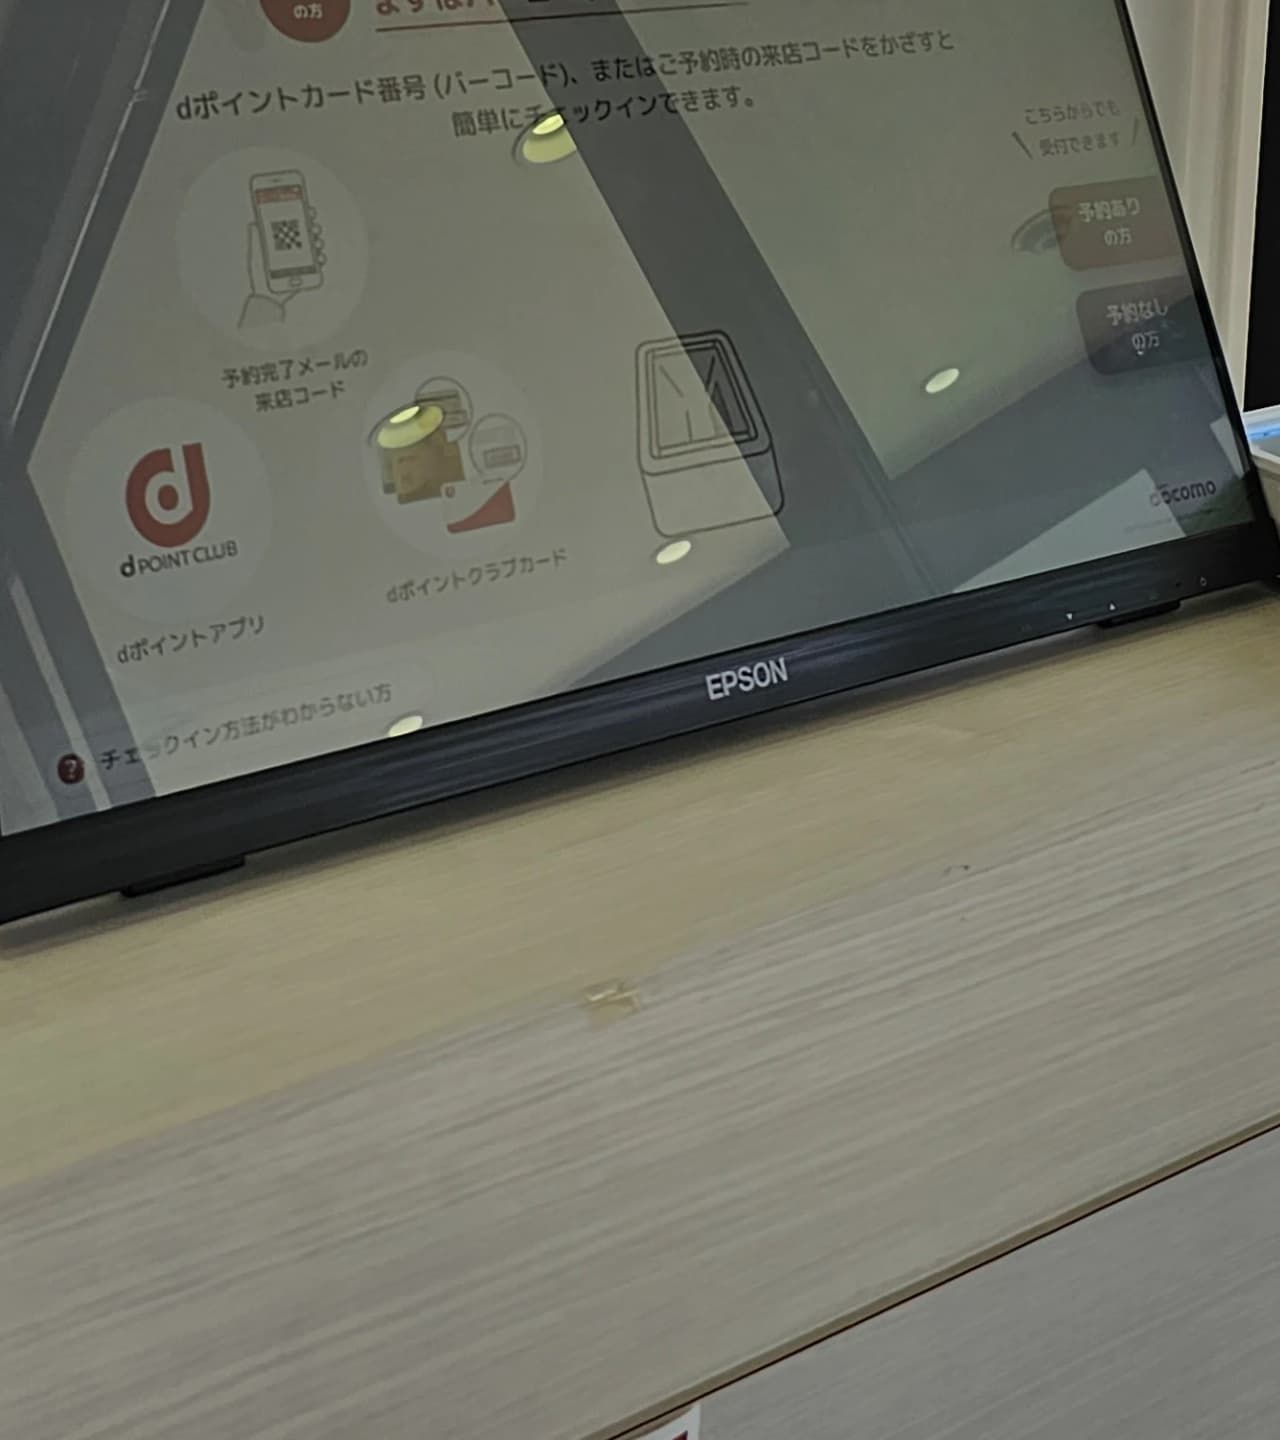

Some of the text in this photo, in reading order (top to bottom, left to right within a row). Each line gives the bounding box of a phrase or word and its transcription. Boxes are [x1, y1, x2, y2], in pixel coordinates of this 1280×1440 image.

[292, 1, 322, 20] の方
[1038, 130, 1120, 157] 受付できます
[1076, 197, 1141, 223] 予約あり
[1106, 299, 1169, 327] 予約なし
[221, 348, 369, 389] 予約完了メールの
[255, 380, 345, 413] 来店コード
[385, 547, 568, 604] dポイントクラブカード
[117, 614, 265, 664] dポイントアプリ
[705, 657, 789, 702] EPSON
[99, 682, 393, 772] チェックイン方法がわからない方
